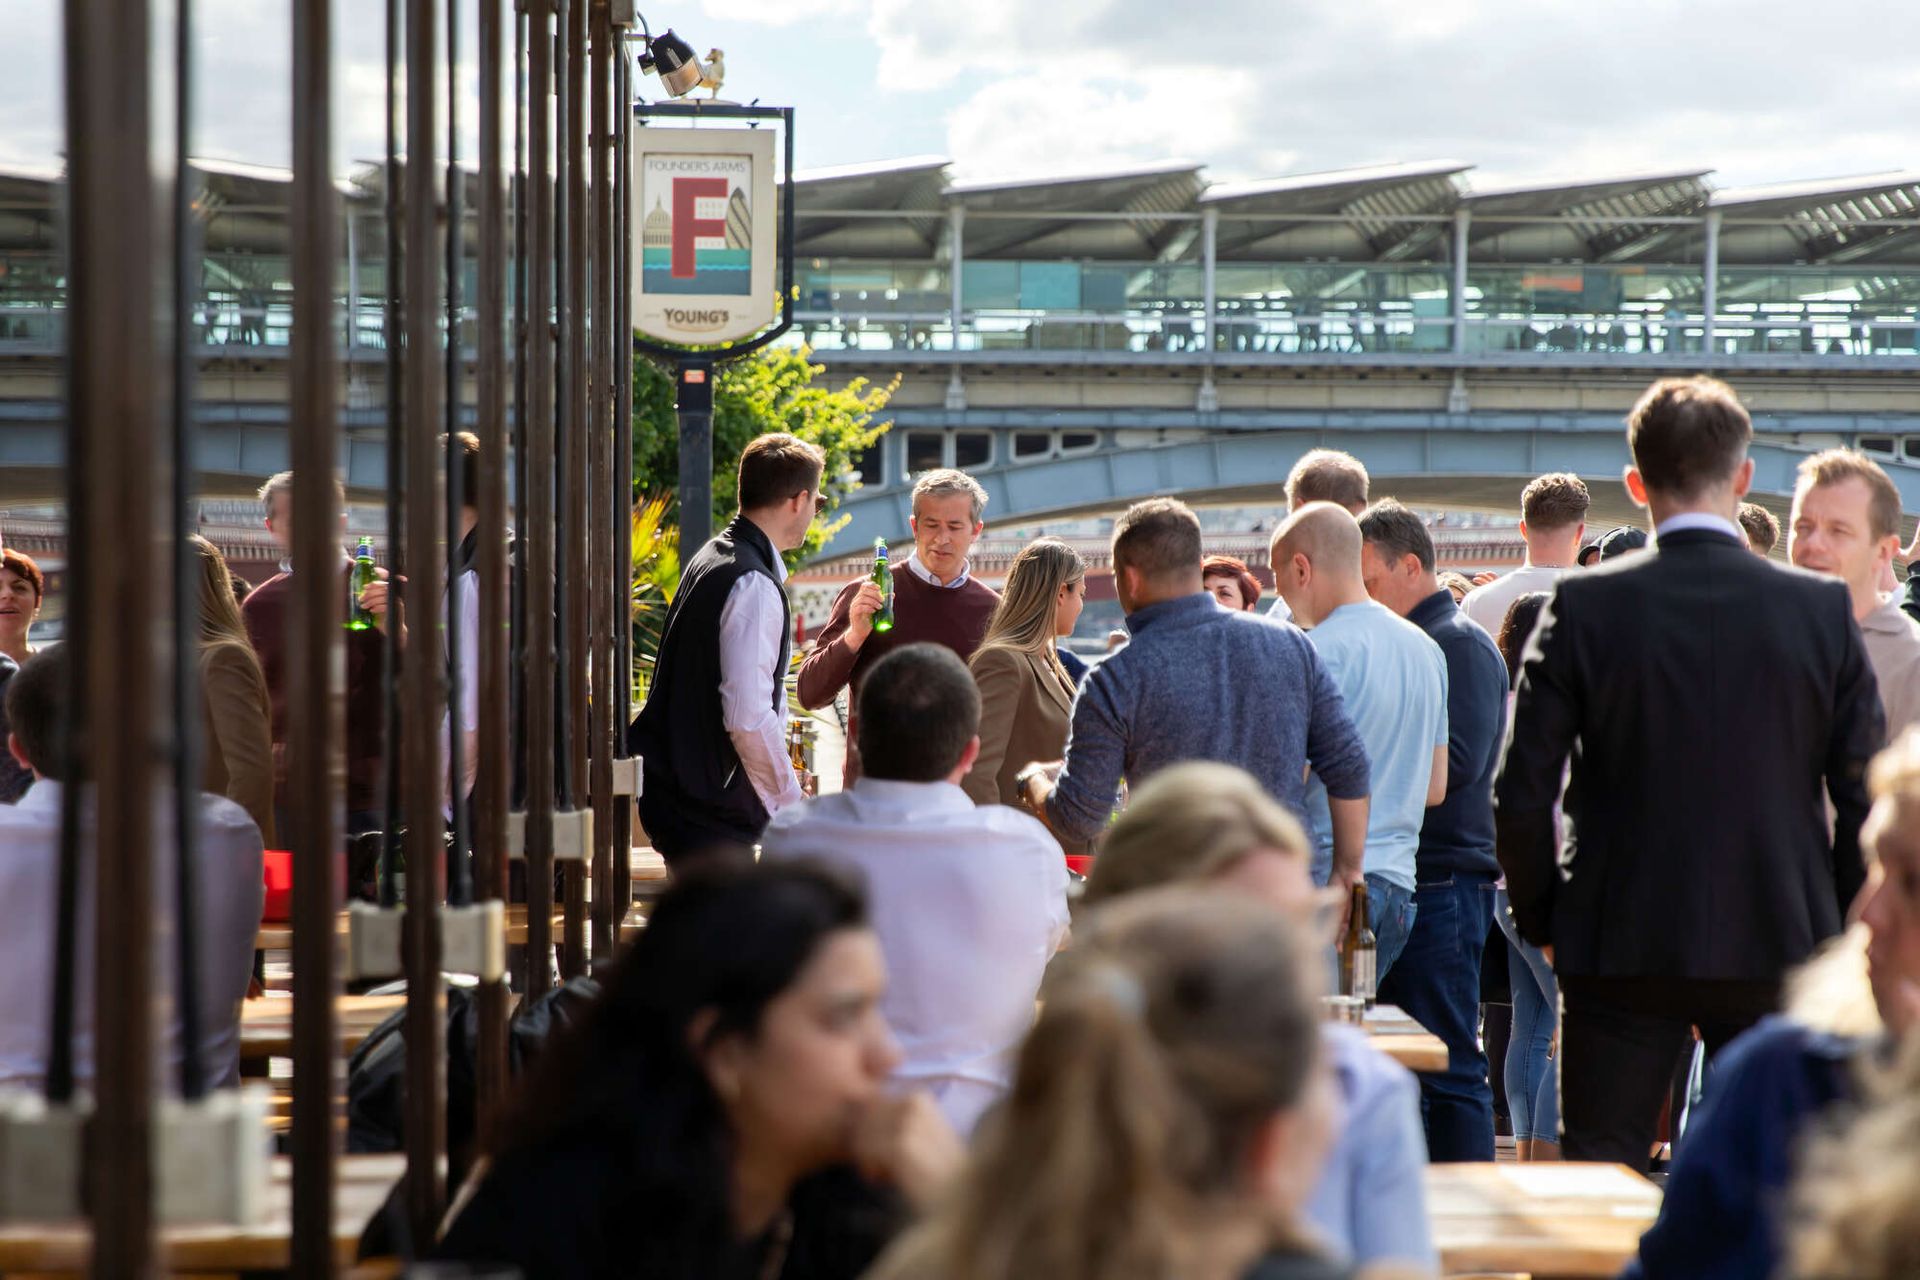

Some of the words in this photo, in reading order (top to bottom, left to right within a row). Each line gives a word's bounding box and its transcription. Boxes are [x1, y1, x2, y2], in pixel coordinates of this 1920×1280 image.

[712, 161, 746, 173] ARMS
[672, 177, 728, 278] F
[664, 308, 729, 323] YOUNG'S
